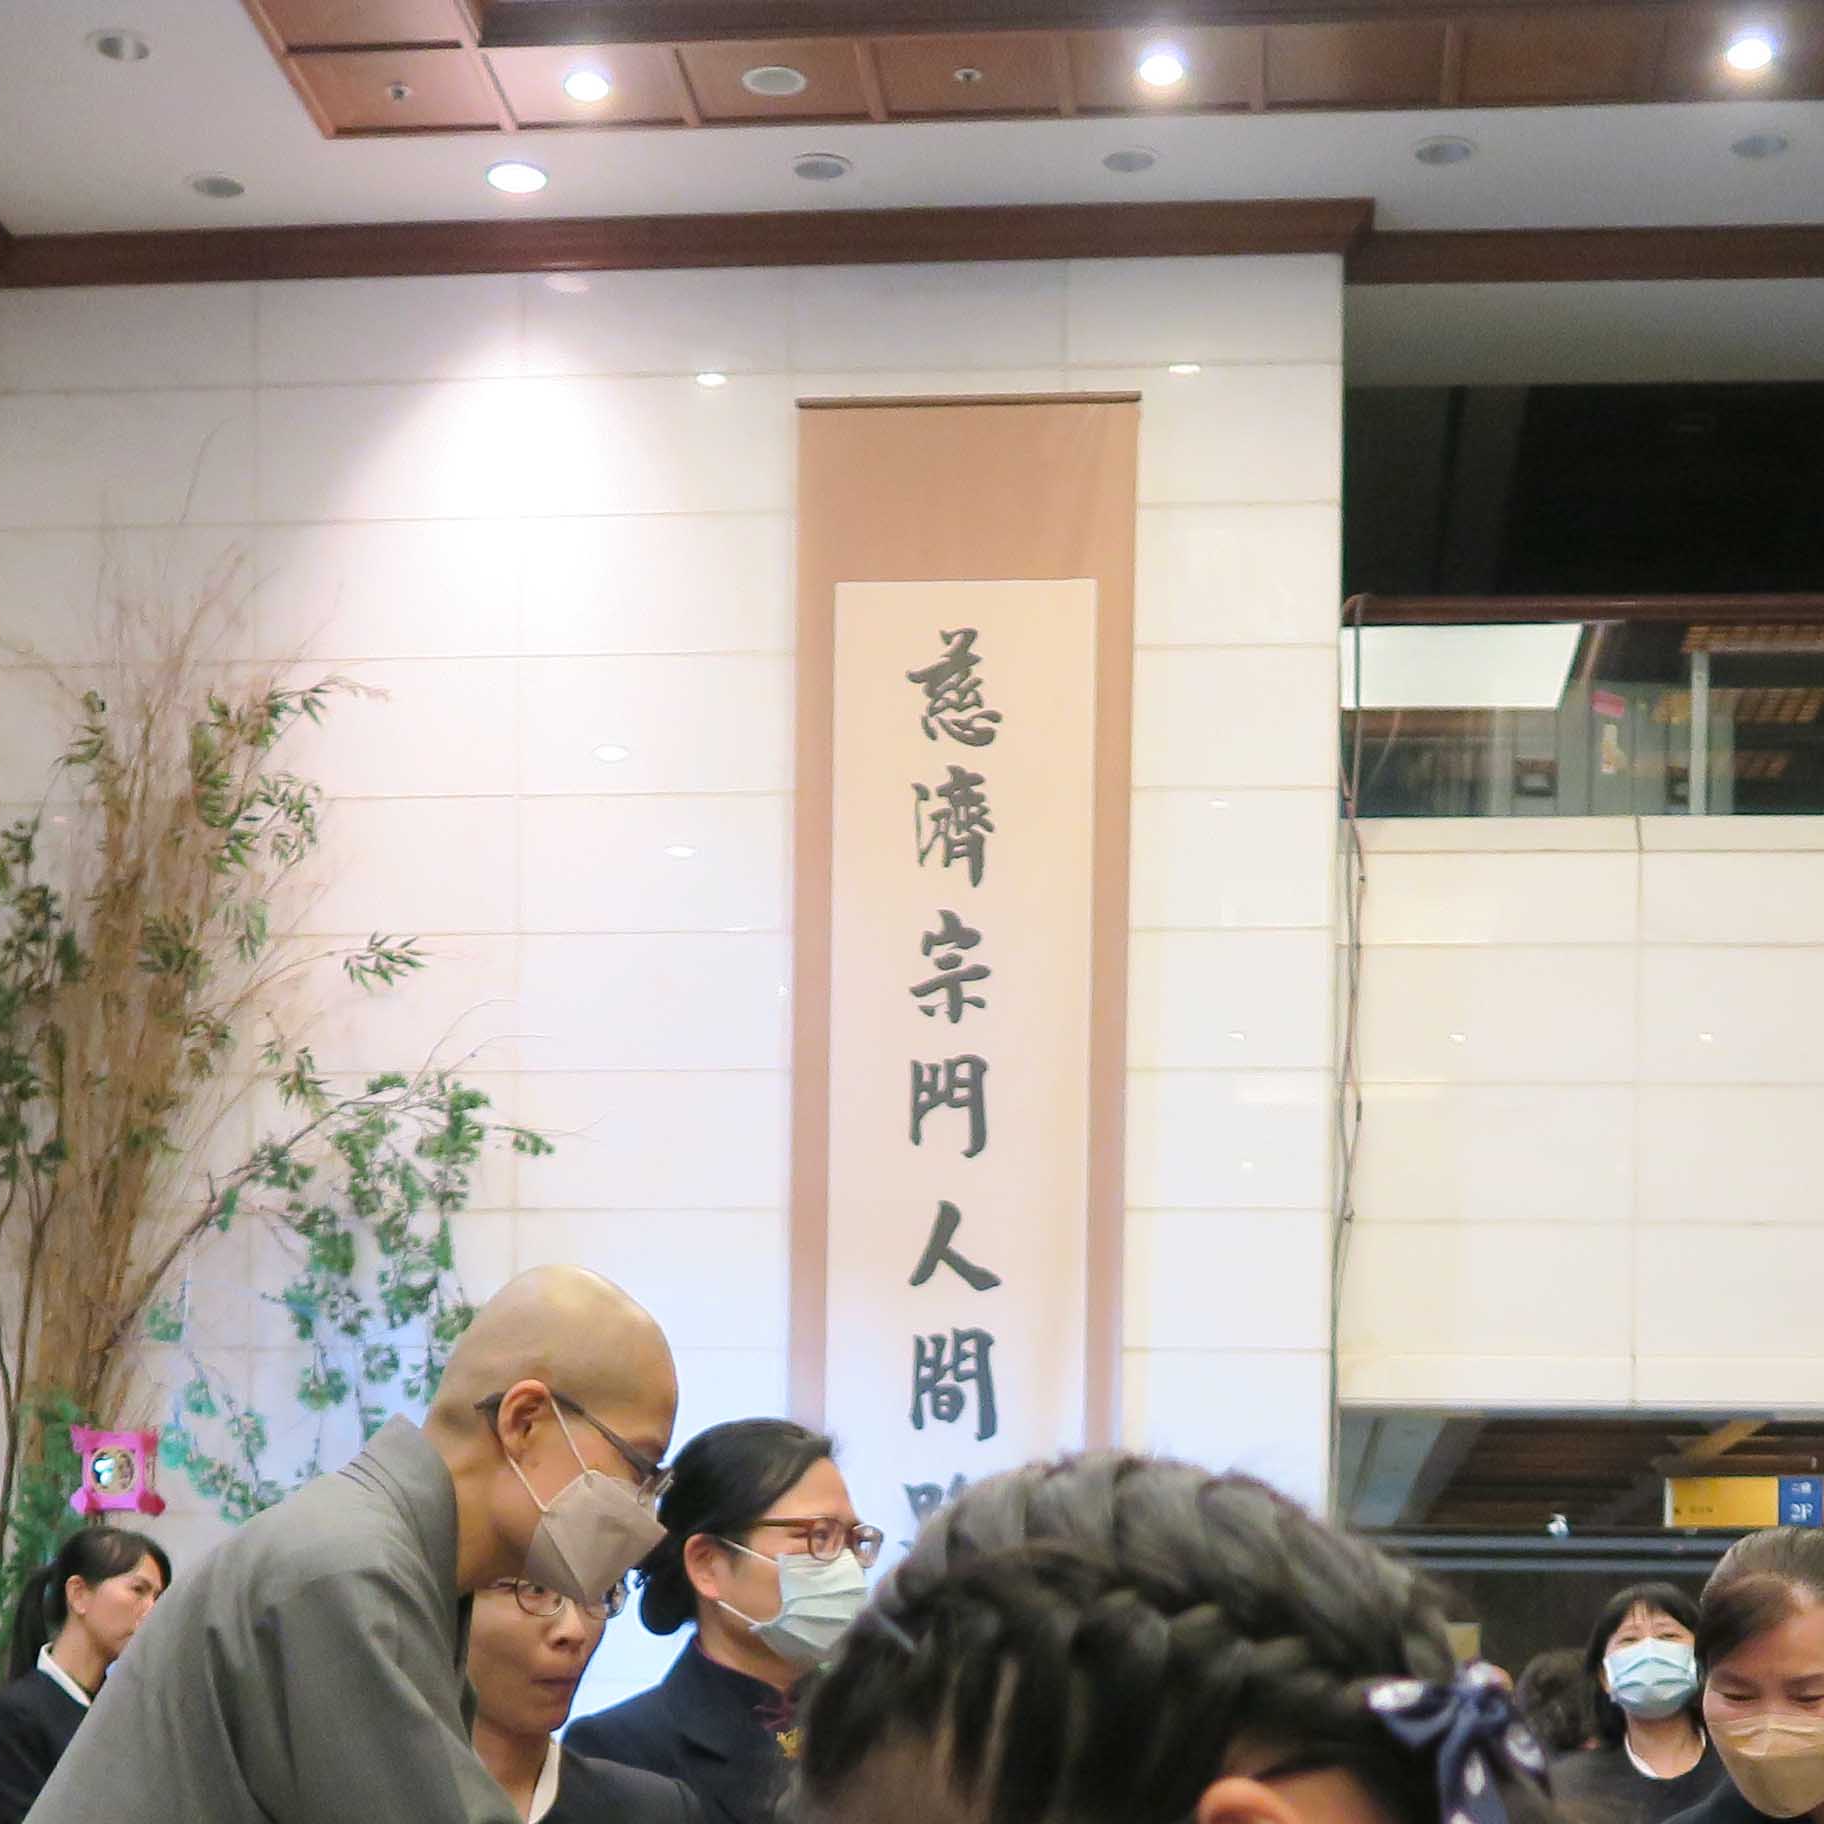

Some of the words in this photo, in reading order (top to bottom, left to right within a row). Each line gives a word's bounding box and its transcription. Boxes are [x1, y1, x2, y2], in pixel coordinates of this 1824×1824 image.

[902, 628, 1004, 1549] 慈濟宗門人間
